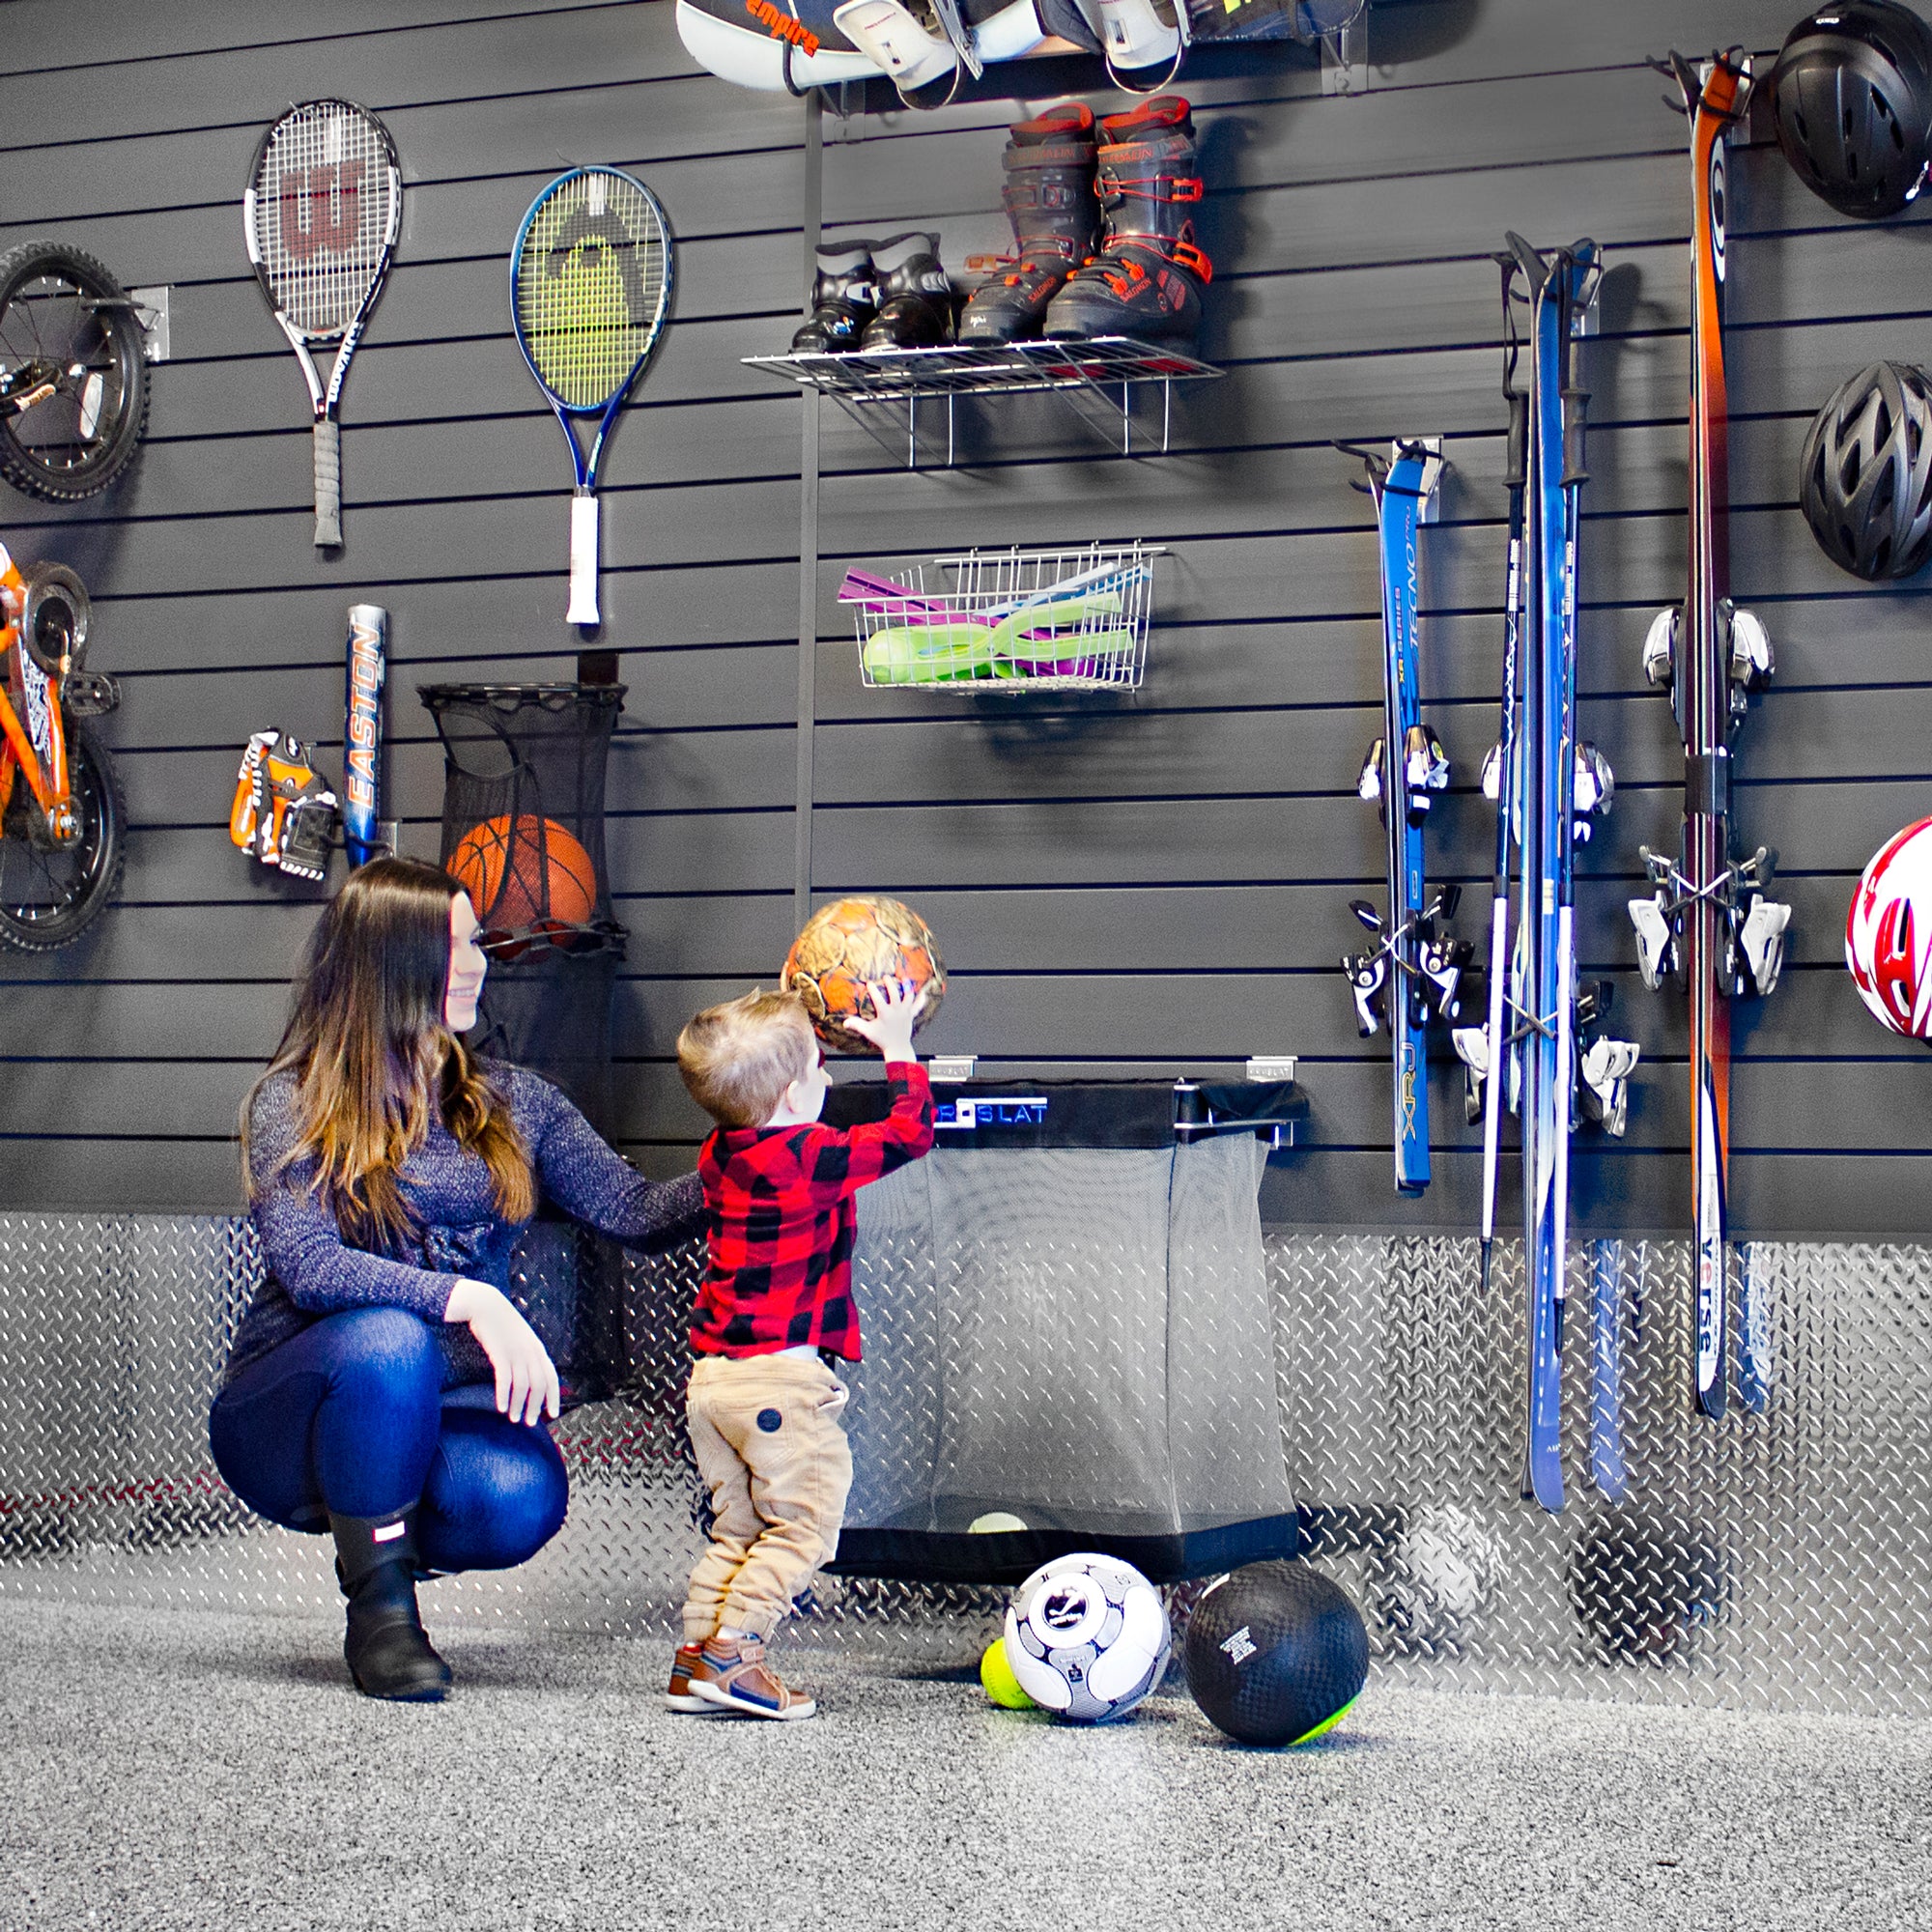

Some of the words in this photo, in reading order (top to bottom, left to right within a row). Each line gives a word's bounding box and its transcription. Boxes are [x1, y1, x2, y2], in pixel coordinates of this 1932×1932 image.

[746, 0, 819, 58] empire
[1394, 586, 1405, 683] XR-SERIES
[1406, 543, 1419, 649] TECNO
[349, 624, 379, 808] EASTON
[1400, 1041, 1417, 1140] XRJ
[1698, 1236, 1713, 1353] verse
